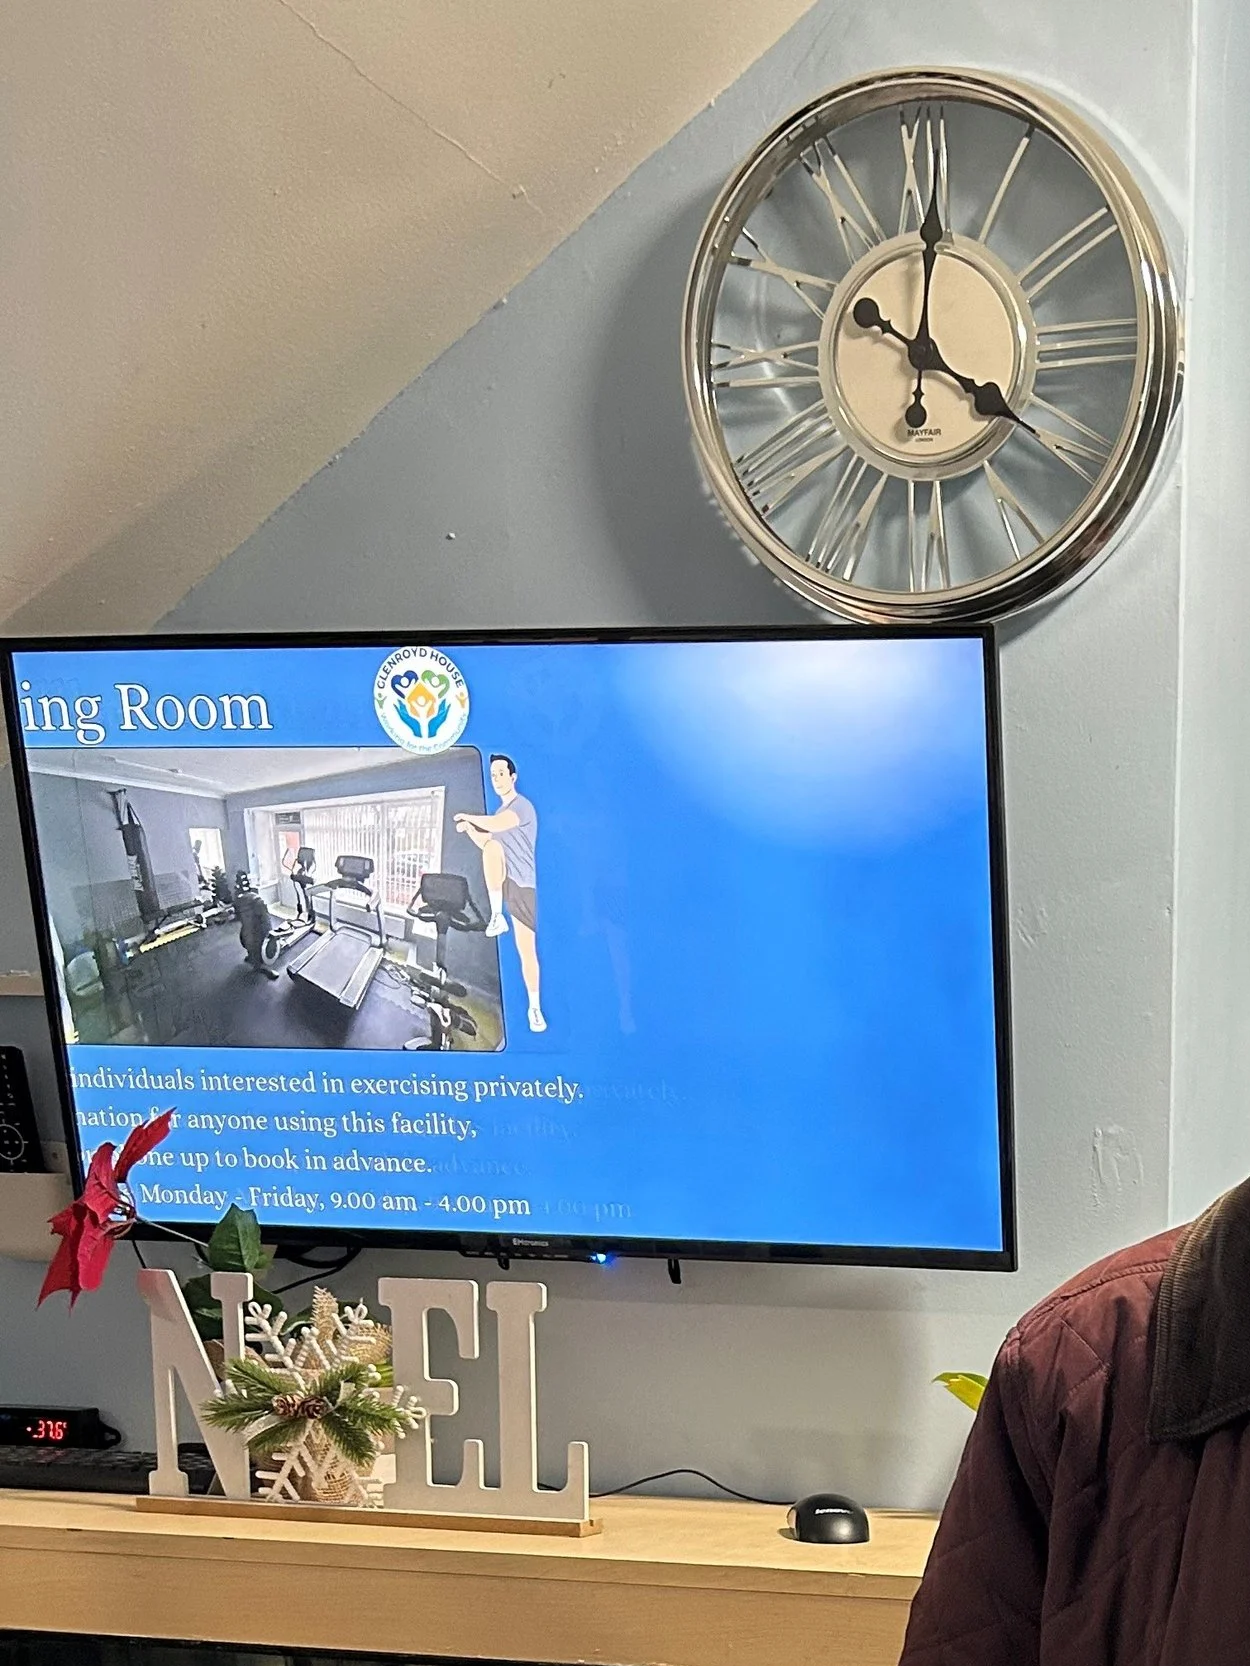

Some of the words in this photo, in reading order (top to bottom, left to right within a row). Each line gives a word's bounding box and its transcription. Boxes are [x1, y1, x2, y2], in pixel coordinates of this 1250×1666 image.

[907, 429, 942, 437] MAYFAIR
[377, 647, 427, 689] GLENROYD
[429, 650, 464, 688] HOUSE
[21, 680, 106, 745] ing
[114, 683, 274, 730] Room
[70, 1066, 195, 1090] individuals
[200, 1069, 316, 1094] interested
[322, 1071, 344, 1094] in
[351, 1073, 469, 1101] exercising
[474, 1074, 584, 1104] privately.
[150, 1106, 181, 1128] fr
[188, 1113, 268, 1135] anyone
[274, 1113, 337, 1137] using
[342, 1111, 385, 1133] this
[391, 1112, 478, 1140] facility,
[180, 1152, 209, 1172] up
[215, 1150, 237, 1168] to
[242, 1147, 299, 1169] book
[305, 1148, 327, 1170] in
[333, 1150, 432, 1173] advance.
[140, 1183, 227, 1209] Monday
[249, 1186, 324, 1212] Friday,
[331, 1192, 376, 1211] 9.00
[382, 1196, 417, 1212] am
[439, 1195, 486, 1213] 4.00
[493, 1198, 531, 1219] pm
